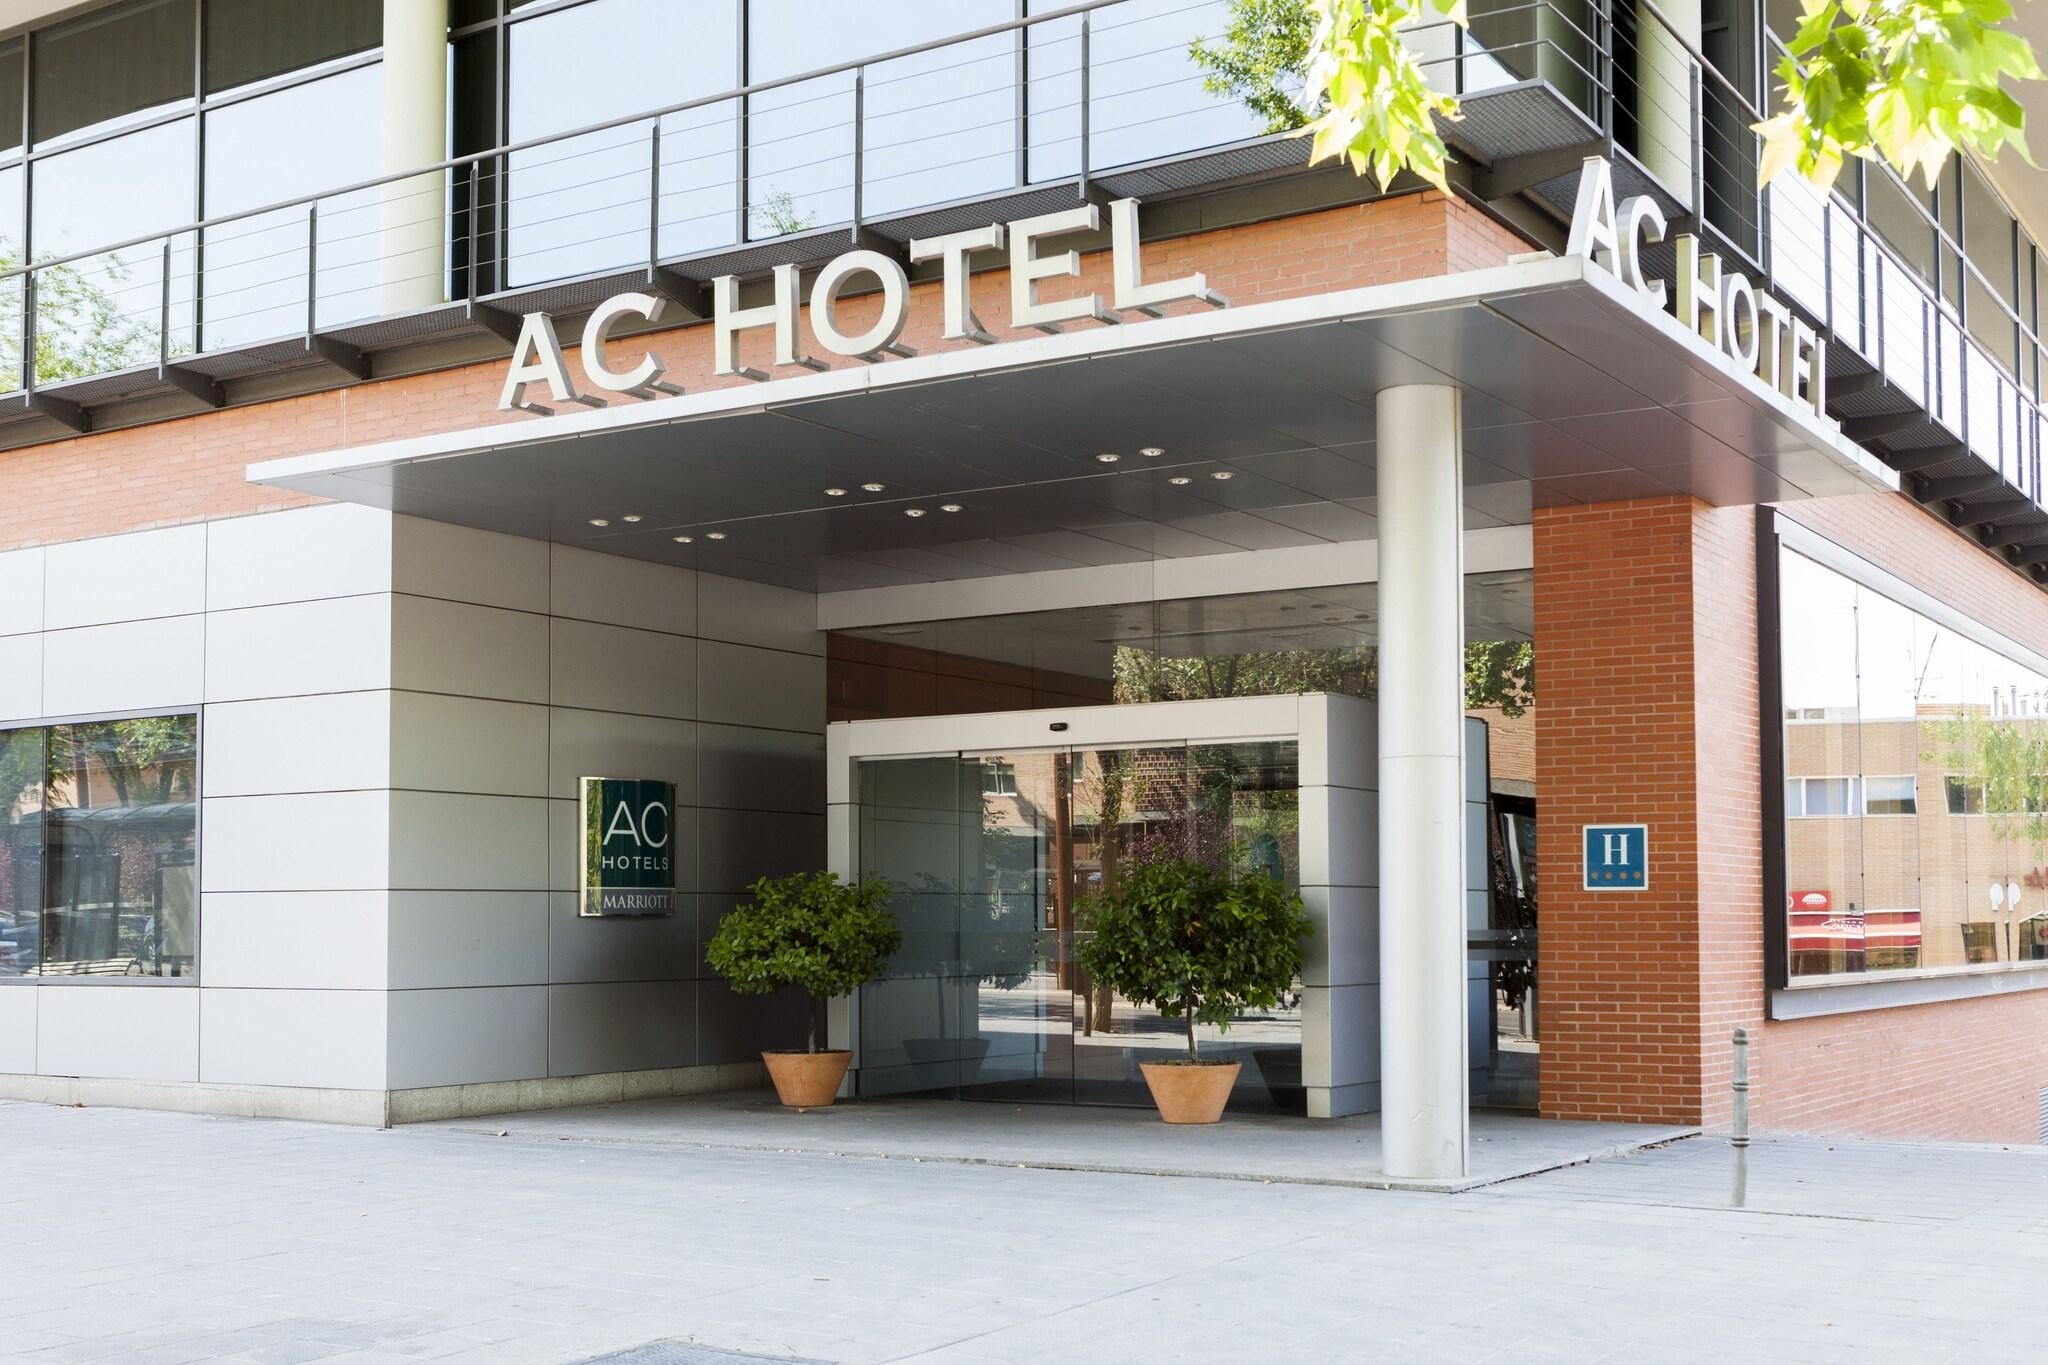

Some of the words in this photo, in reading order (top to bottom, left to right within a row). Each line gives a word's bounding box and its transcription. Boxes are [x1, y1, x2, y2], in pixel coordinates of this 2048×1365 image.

[498, 291, 668, 411] AC
[711, 196, 1210, 377] HOTEL
[1565, 154, 1668, 310] AC
[1675, 232, 1842, 434] HOTEL
[602, 800, 669, 849] AC
[601, 855, 669, 871] HOTELS
[1601, 833, 1631, 866] H
[602, 894, 669, 910] MARRIOTT
